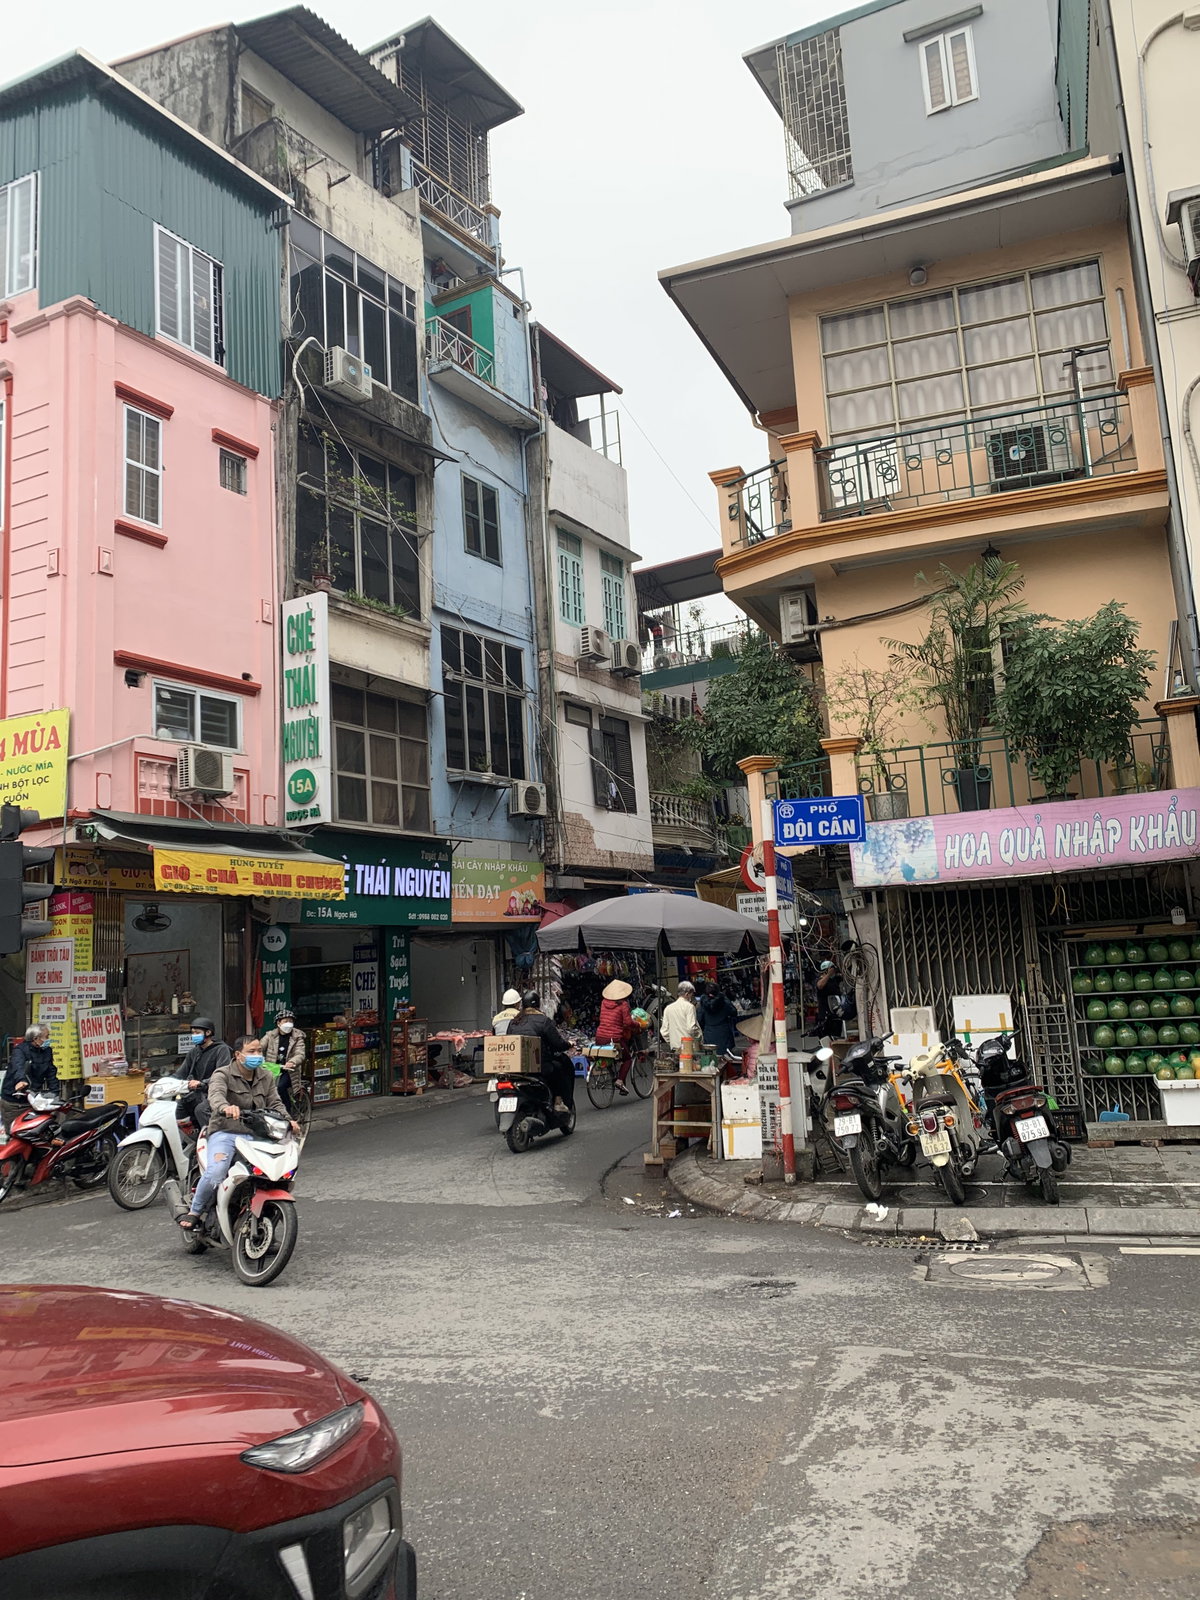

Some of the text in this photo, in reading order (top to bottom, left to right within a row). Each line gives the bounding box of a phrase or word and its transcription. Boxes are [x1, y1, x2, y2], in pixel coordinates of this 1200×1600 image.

[286, 602, 316, 655] CHÈ
[285, 655, 319, 710] THÁI
[6, 763, 33, 776] NƯỚC
[35, 760, 54, 771] MÍA
[12, 779, 30, 791] BỘT
[32, 775, 50, 787] LỌC
[289, 777, 313, 795] 15A
[810, 801, 838, 814] PHỐ
[783, 815, 856, 841] ĐỘI CẤN
[944, 795, 1197, 869] HOA QUẢ NHẬP KHẨU
[229, 857, 285, 870] HÙNG TUYẾT
[467, 860, 483, 870] CÂY
[484, 861, 506, 873] NHẬP
[160, 863, 191, 882] GIÒ
[206, 867, 239, 885] CHẢ
[252, 870, 292, 888] BÁNH
[355, 858, 391, 896] THÁI
[394, 862, 451, 899] NGUYÊN
[477, 884, 501, 904] ĐẠT
[317, 906, 333, 918] 15A
[355, 966, 377, 991] CHÈ
[388, 972, 409, 990] Tuyết
[80, 1012, 104, 1038] BÁNH
[83, 1039, 123, 1058] BÁNH BAO
[1021, 1127, 1047, 1141] 875.98
